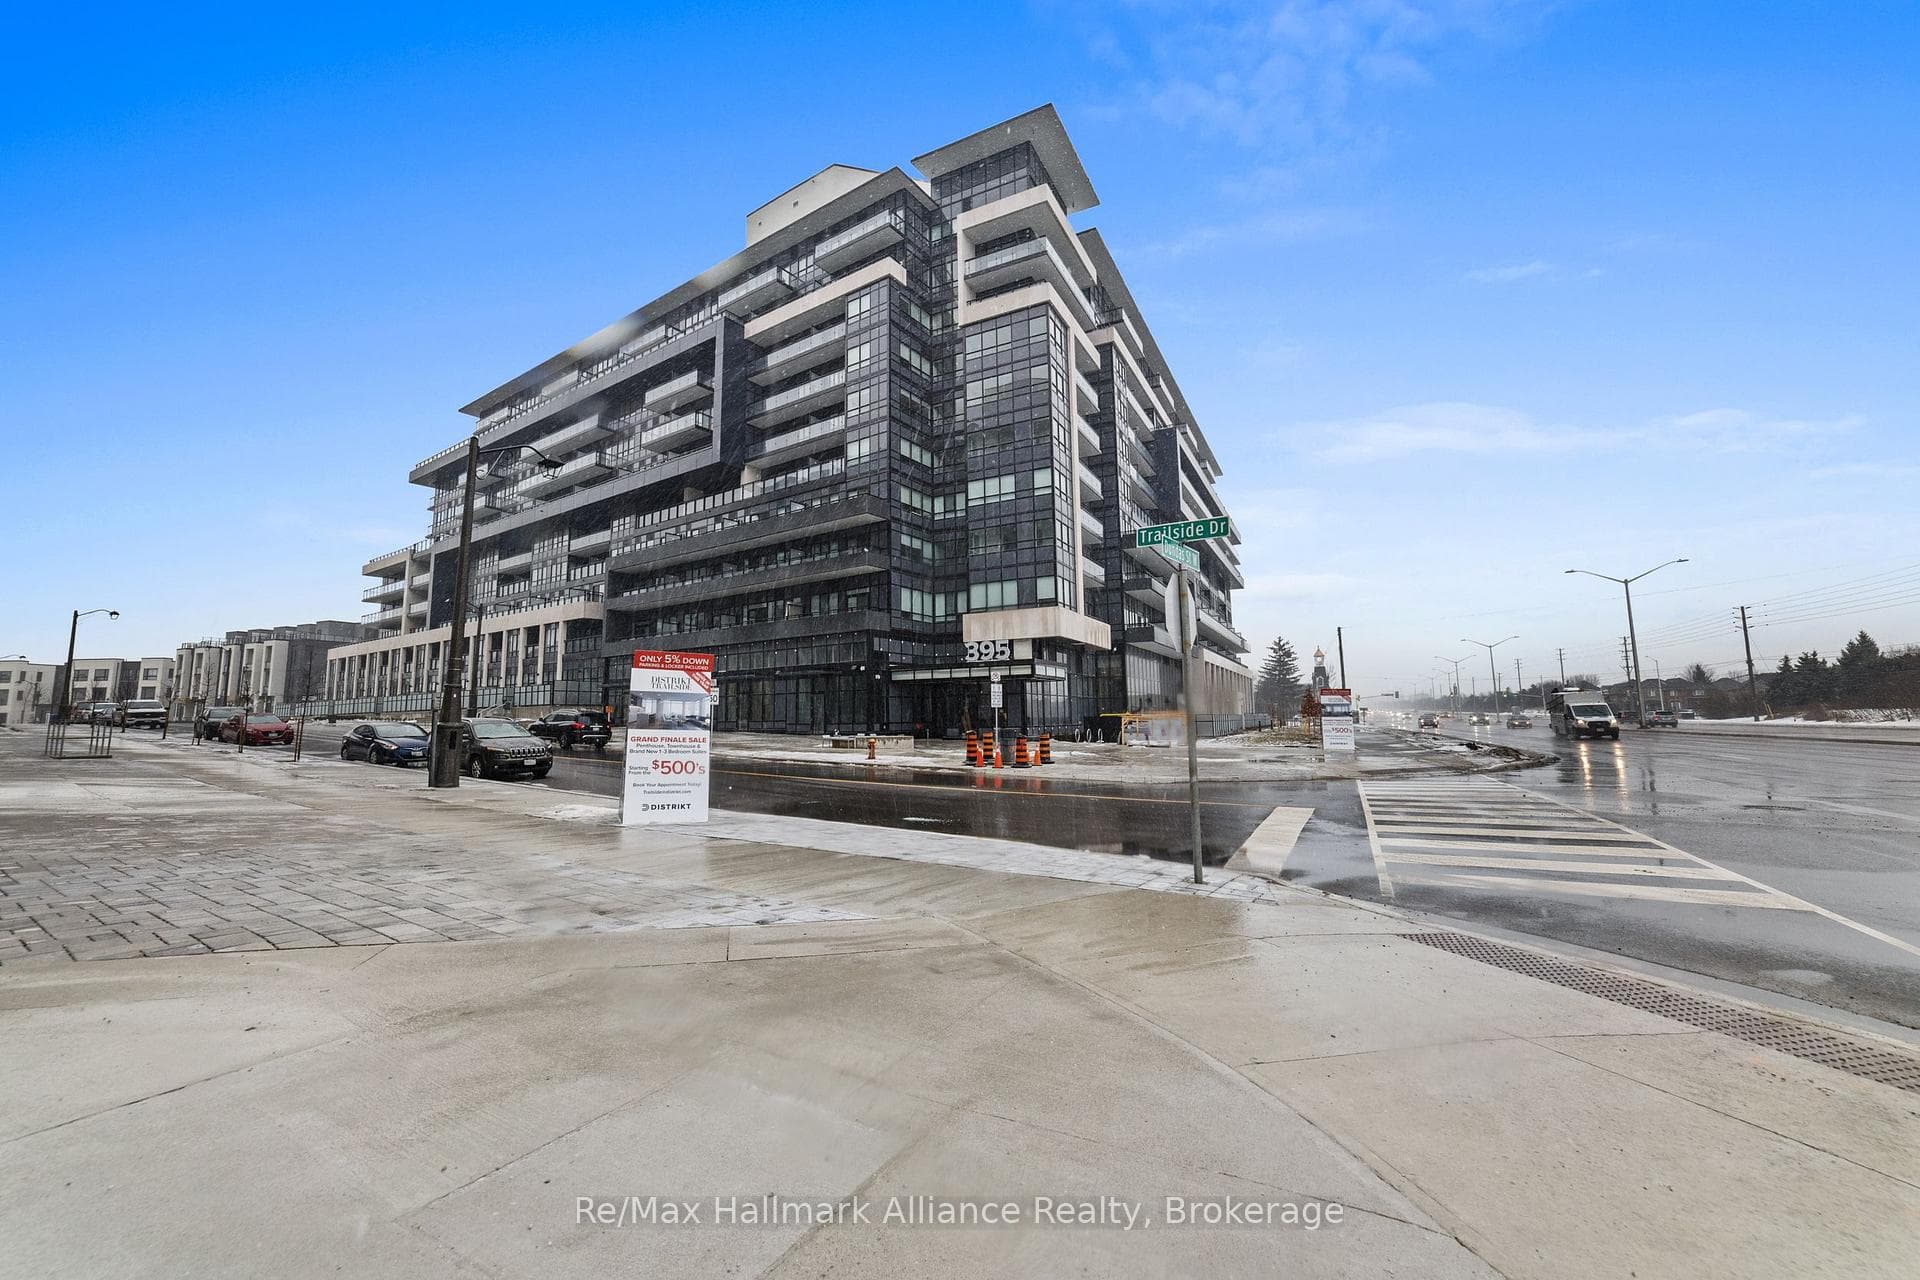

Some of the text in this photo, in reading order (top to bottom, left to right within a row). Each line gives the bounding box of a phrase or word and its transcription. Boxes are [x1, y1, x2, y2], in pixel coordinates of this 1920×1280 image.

[1140, 520, 1226, 543] Trailside Dr
[965, 640, 1010, 661] 395
[665, 654, 680, 663] 5%
[652, 676, 691, 684] DISTRIKT
